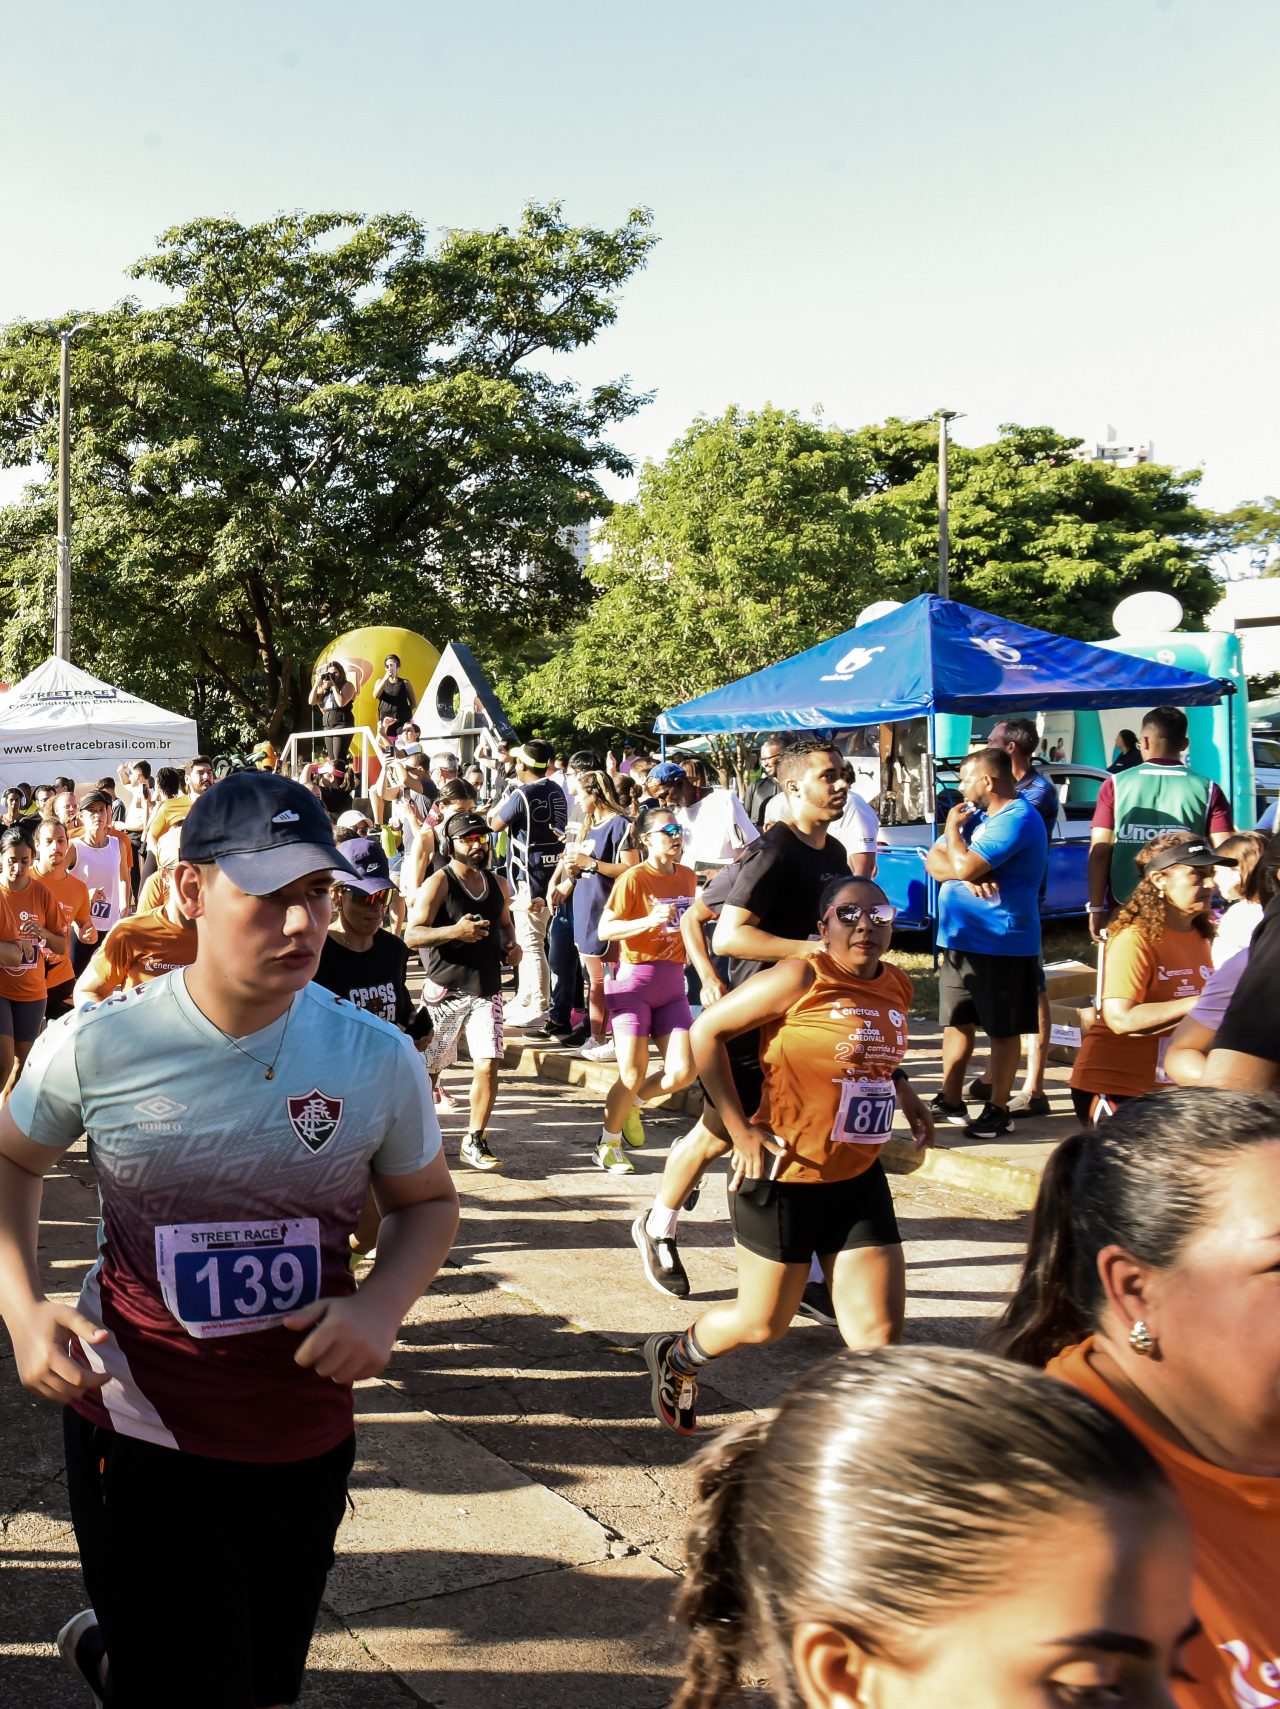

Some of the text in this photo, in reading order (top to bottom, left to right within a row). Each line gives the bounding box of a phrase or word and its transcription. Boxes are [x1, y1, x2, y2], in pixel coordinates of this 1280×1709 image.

[20, 690, 71, 700] STREET
[3, 739, 172, 754] www.streetracebrasil.com.br
[349, 982, 396, 1007] CROSS
[848, 1033, 886, 1043] CREDIVALE
[855, 1027, 880, 1036] SICOOB
[853, 1099, 894, 1133] 870
[191, 1228, 280, 1244] STREET RACE
[195, 1252, 305, 1318] 139
